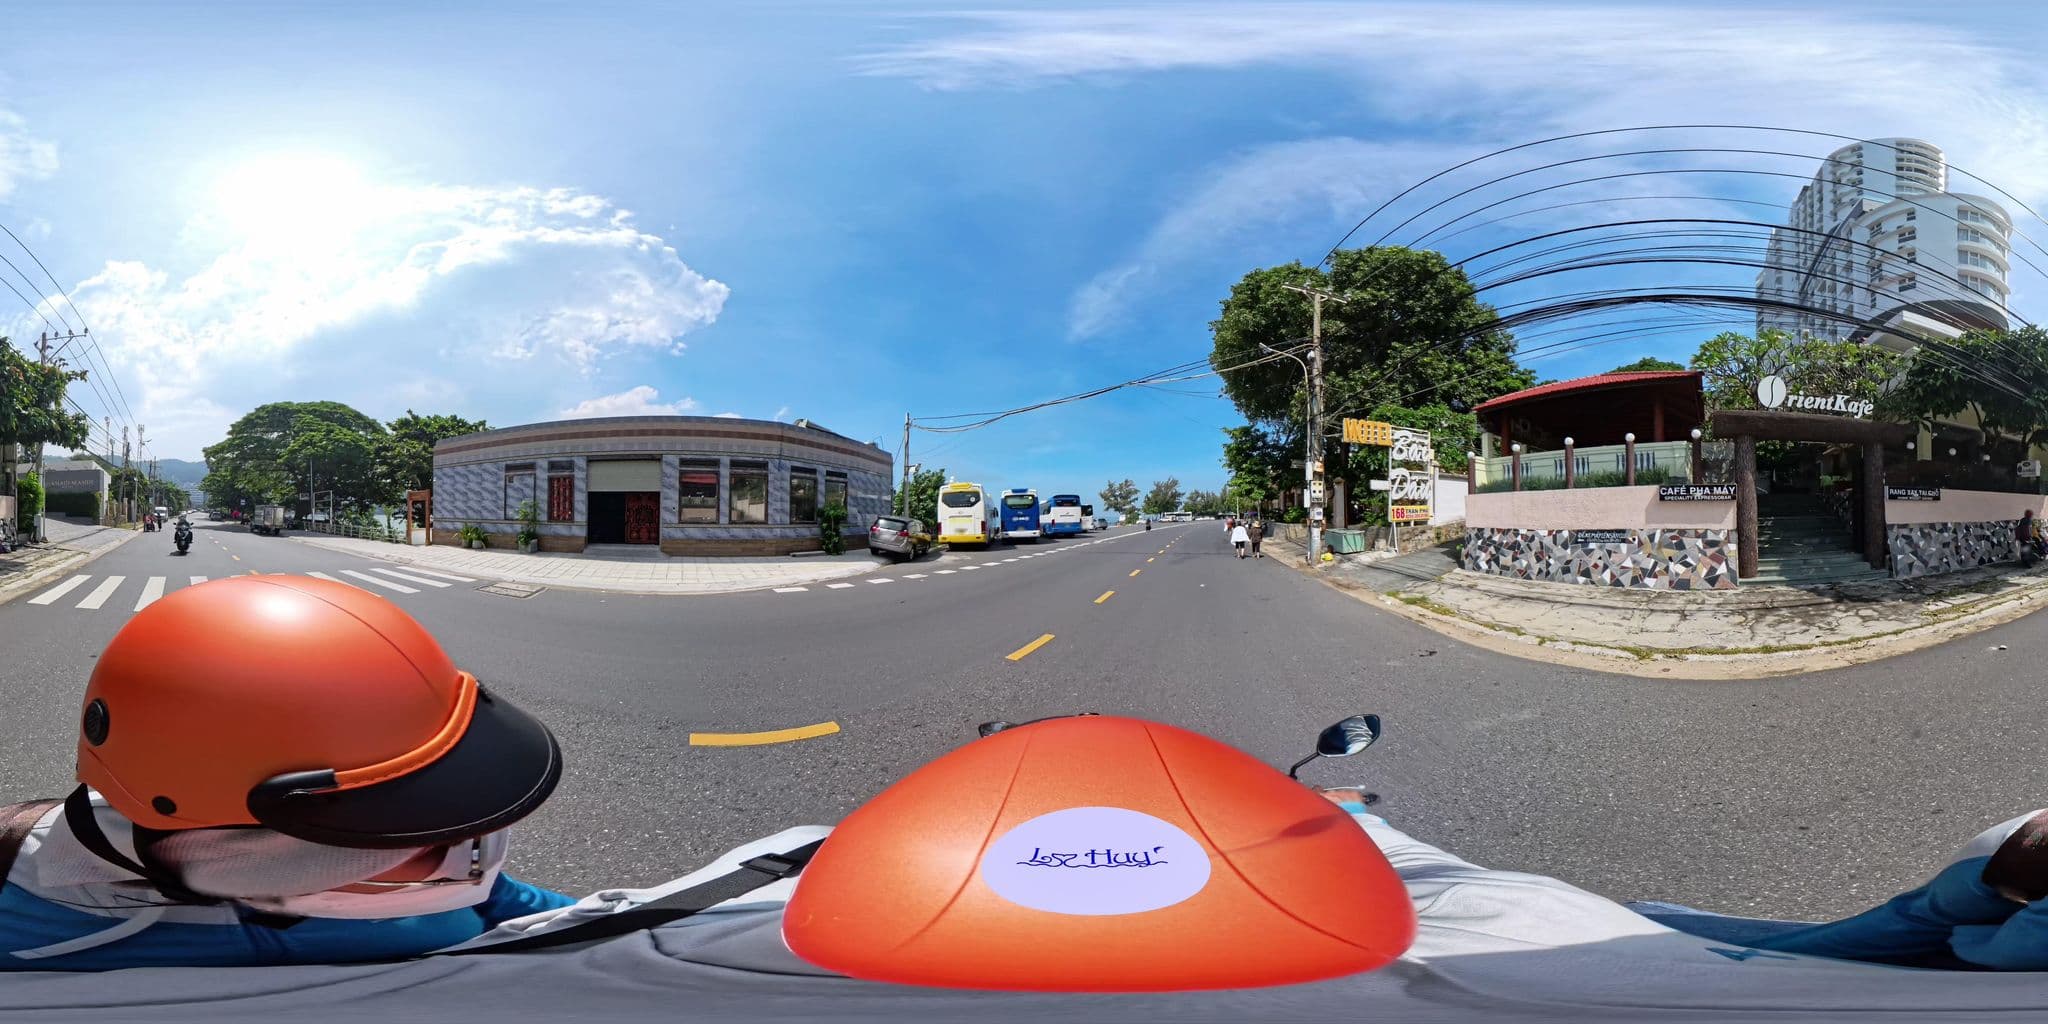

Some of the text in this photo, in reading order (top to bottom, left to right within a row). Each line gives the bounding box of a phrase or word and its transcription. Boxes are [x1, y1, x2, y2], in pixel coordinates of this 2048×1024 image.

[1343, 418, 1393, 447] MOTEL
[1689, 486, 1711, 495] PHA
[1713, 485, 1735, 495] MÁY
[1889, 488, 1906, 496] RANG
[1391, 508, 1405, 519] 168
